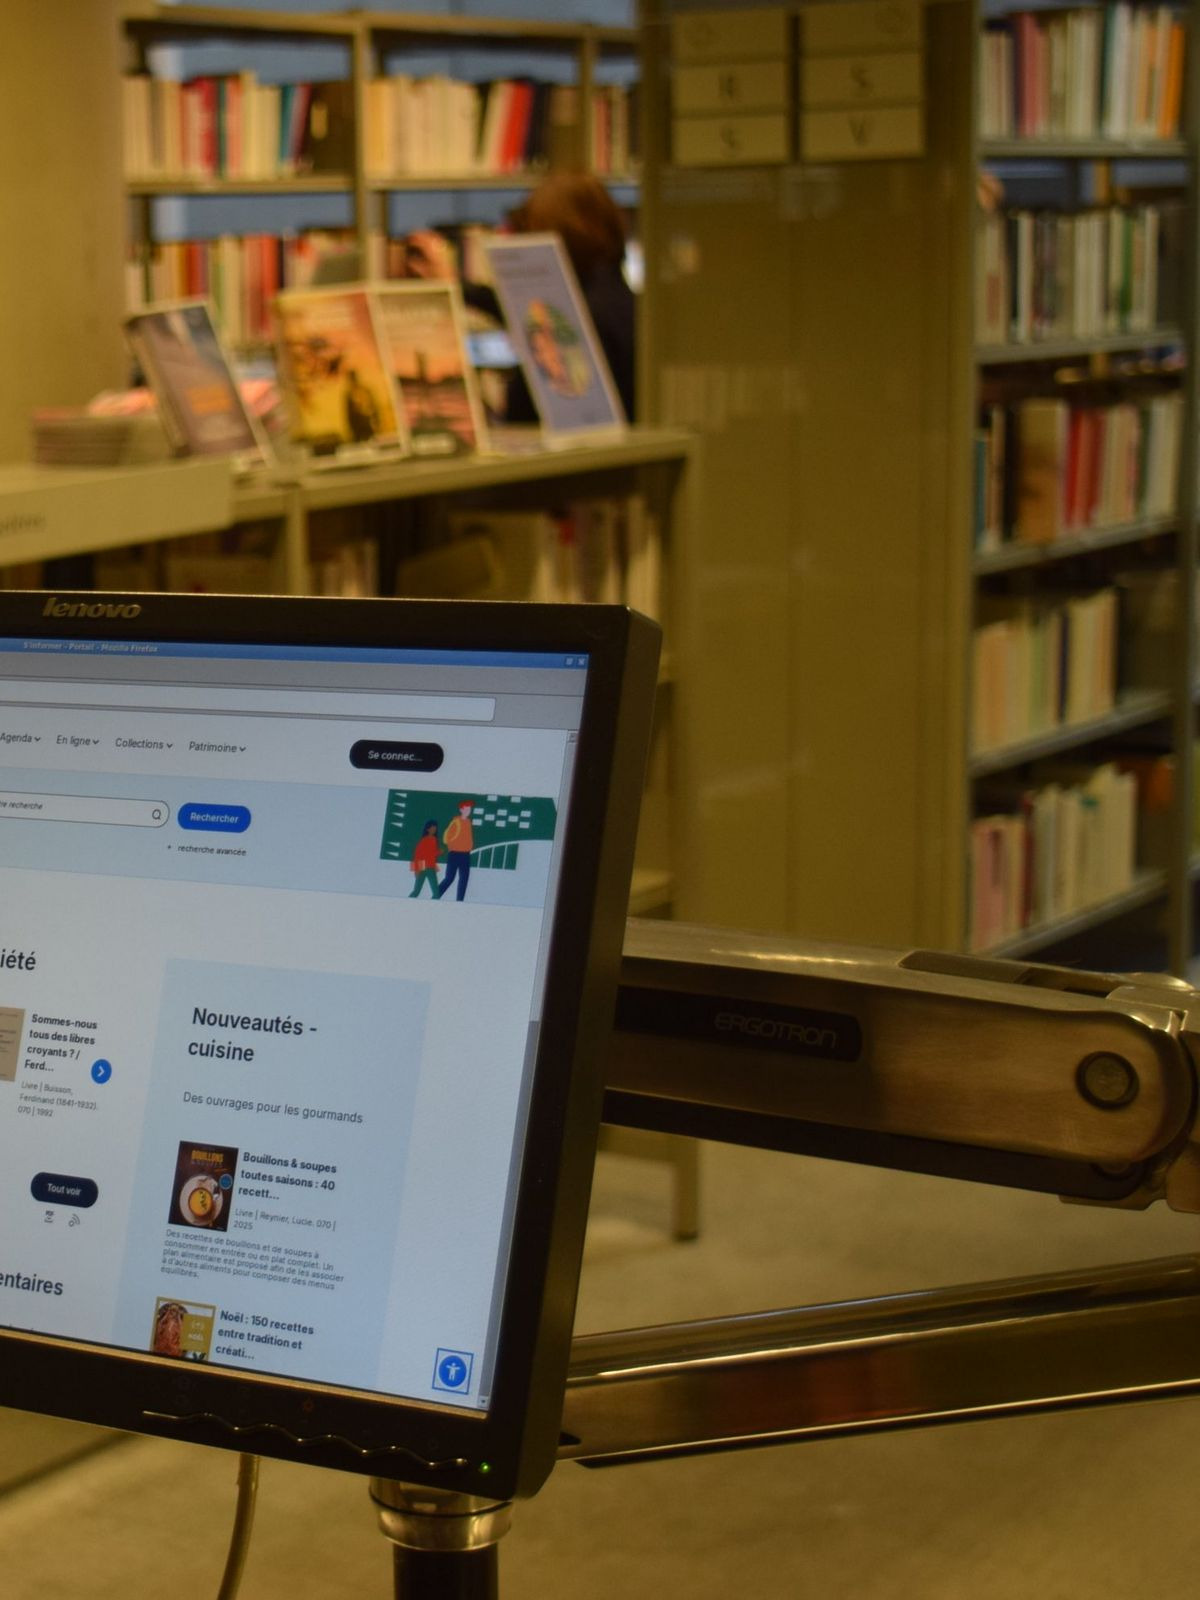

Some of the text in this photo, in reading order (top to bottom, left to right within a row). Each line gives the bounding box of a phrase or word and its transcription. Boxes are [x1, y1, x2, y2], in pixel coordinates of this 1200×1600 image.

[42, 597, 142, 619] lenovo
[130, 644, 158, 653] Firefox
[0, 732, 33, 744] Agenda
[56, 734, 91, 747] En ligne
[115, 737, 164, 750] Collections
[188, 740, 238, 753] Patrimoine
[368, 750, 380, 760] Se
[8, 800, 43, 811] recherche
[190, 811, 239, 824] Rechercher
[177, 844, 247, 856] recherche avancée
[31, 1013, 98, 1030] Sommes-nous
[192, 1006, 304, 1036] Nouveautés
[29, 1029, 96, 1046] tous des libres
[27, 1045, 68, 1058] croyants
[188, 1038, 255, 1062] cuisine
[21, 1080, 38, 1090] Livre
[19, 1092, 55, 1105] Ferdinand
[17, 1105, 54, 1117] 070 1992
[183, 1091, 364, 1124] Des ouvrages pour les gourmands
[243, 1151, 337, 1174] Bouillons & soupes
[241, 1169, 336, 1191] toutes saisons 40
[47, 1182, 82, 1196] Tout voir
[235, 1207, 253, 1218] Livre
[233, 1219, 254, 1231] 2025
[166, 1228, 180, 1239] Des
[182, 1231, 212, 1243] recettes
[214, 1234, 224, 1245] de
[225, 1237, 260, 1251] bouillons
[262, 1241, 271, 1251] et
[272, 1243, 282, 1253] de
[284, 1247, 313, 1259] soupes
[164, 1239, 208, 1252] consommer
[210, 1245, 219, 1253] en
[221, 1247, 246, 1258] entrée
[248, 1251, 257, 1260] ou
[259, 1253, 269, 1262] en
[271, 1254, 286, 1265] plat
[323, 1262, 334, 1271] Un
[163, 1248, 344, 1283] plan alimentaire est proposé afin de les associer
[168, 1256, 198, 1269] d'autres
[200, 1260, 231, 1274] aliments
[232, 1267, 251, 1278] pour
[252, 1271, 291, 1284] composer
[292, 1276, 306, 1286] des
[308, 1279, 336, 1290] menus
[220, 1309, 315, 1335] Noël 150 recettes
[218, 1328, 245, 1340] entre
[247, 1331, 290, 1348] tradition
[291, 1339, 303, 1350] et
